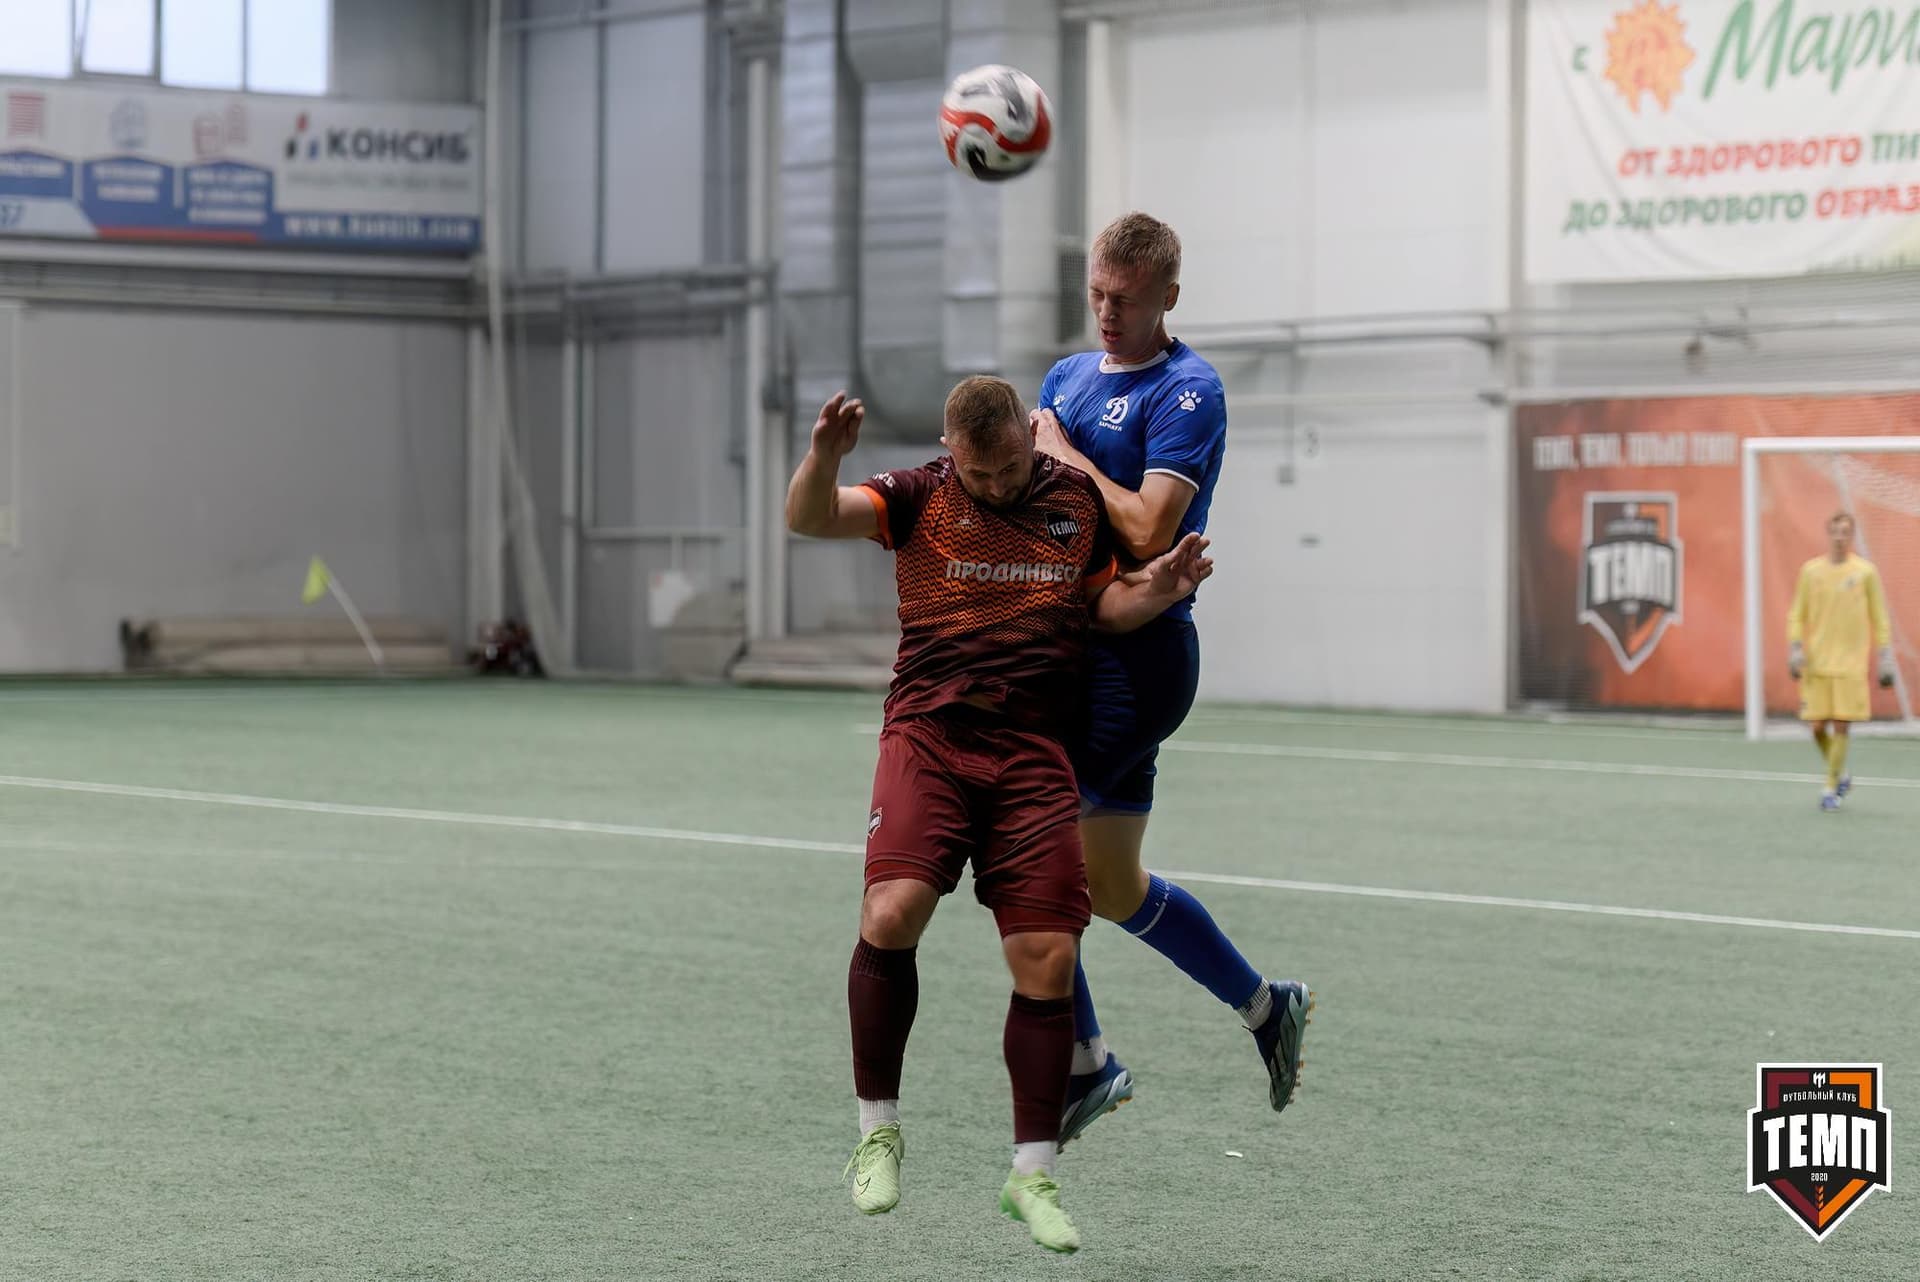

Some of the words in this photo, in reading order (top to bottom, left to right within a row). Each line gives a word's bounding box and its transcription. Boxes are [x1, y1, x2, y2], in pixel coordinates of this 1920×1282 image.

[328, 129, 470, 162] КОНСИБ
[1618, 147, 1660, 179] ОТ
[1665, 134, 1865, 181] ЗДОРОВОГО
[1562, 198, 1609, 235] ДО
[1615, 189, 1809, 232] ЗДОРОВОГО
[1049, 520, 1078, 537] ТЕМП
[1588, 541, 1674, 607] ТЕМП
